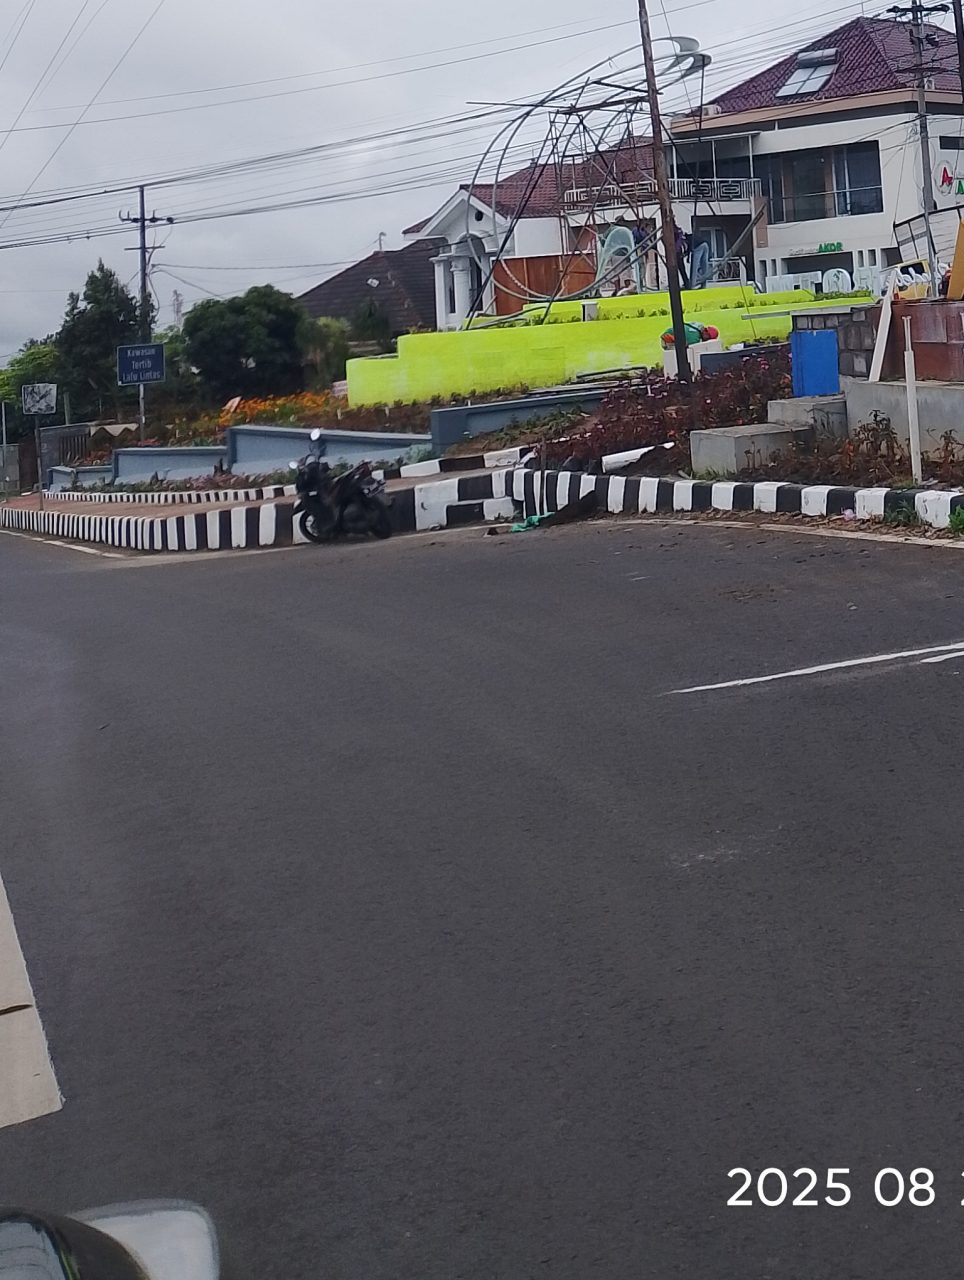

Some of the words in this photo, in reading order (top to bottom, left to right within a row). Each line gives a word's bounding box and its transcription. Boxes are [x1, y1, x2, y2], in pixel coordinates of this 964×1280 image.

[127, 349, 155, 357] Kawasan
[132, 360, 152, 370] Tertib
[122, 372, 138, 382] Lalu
